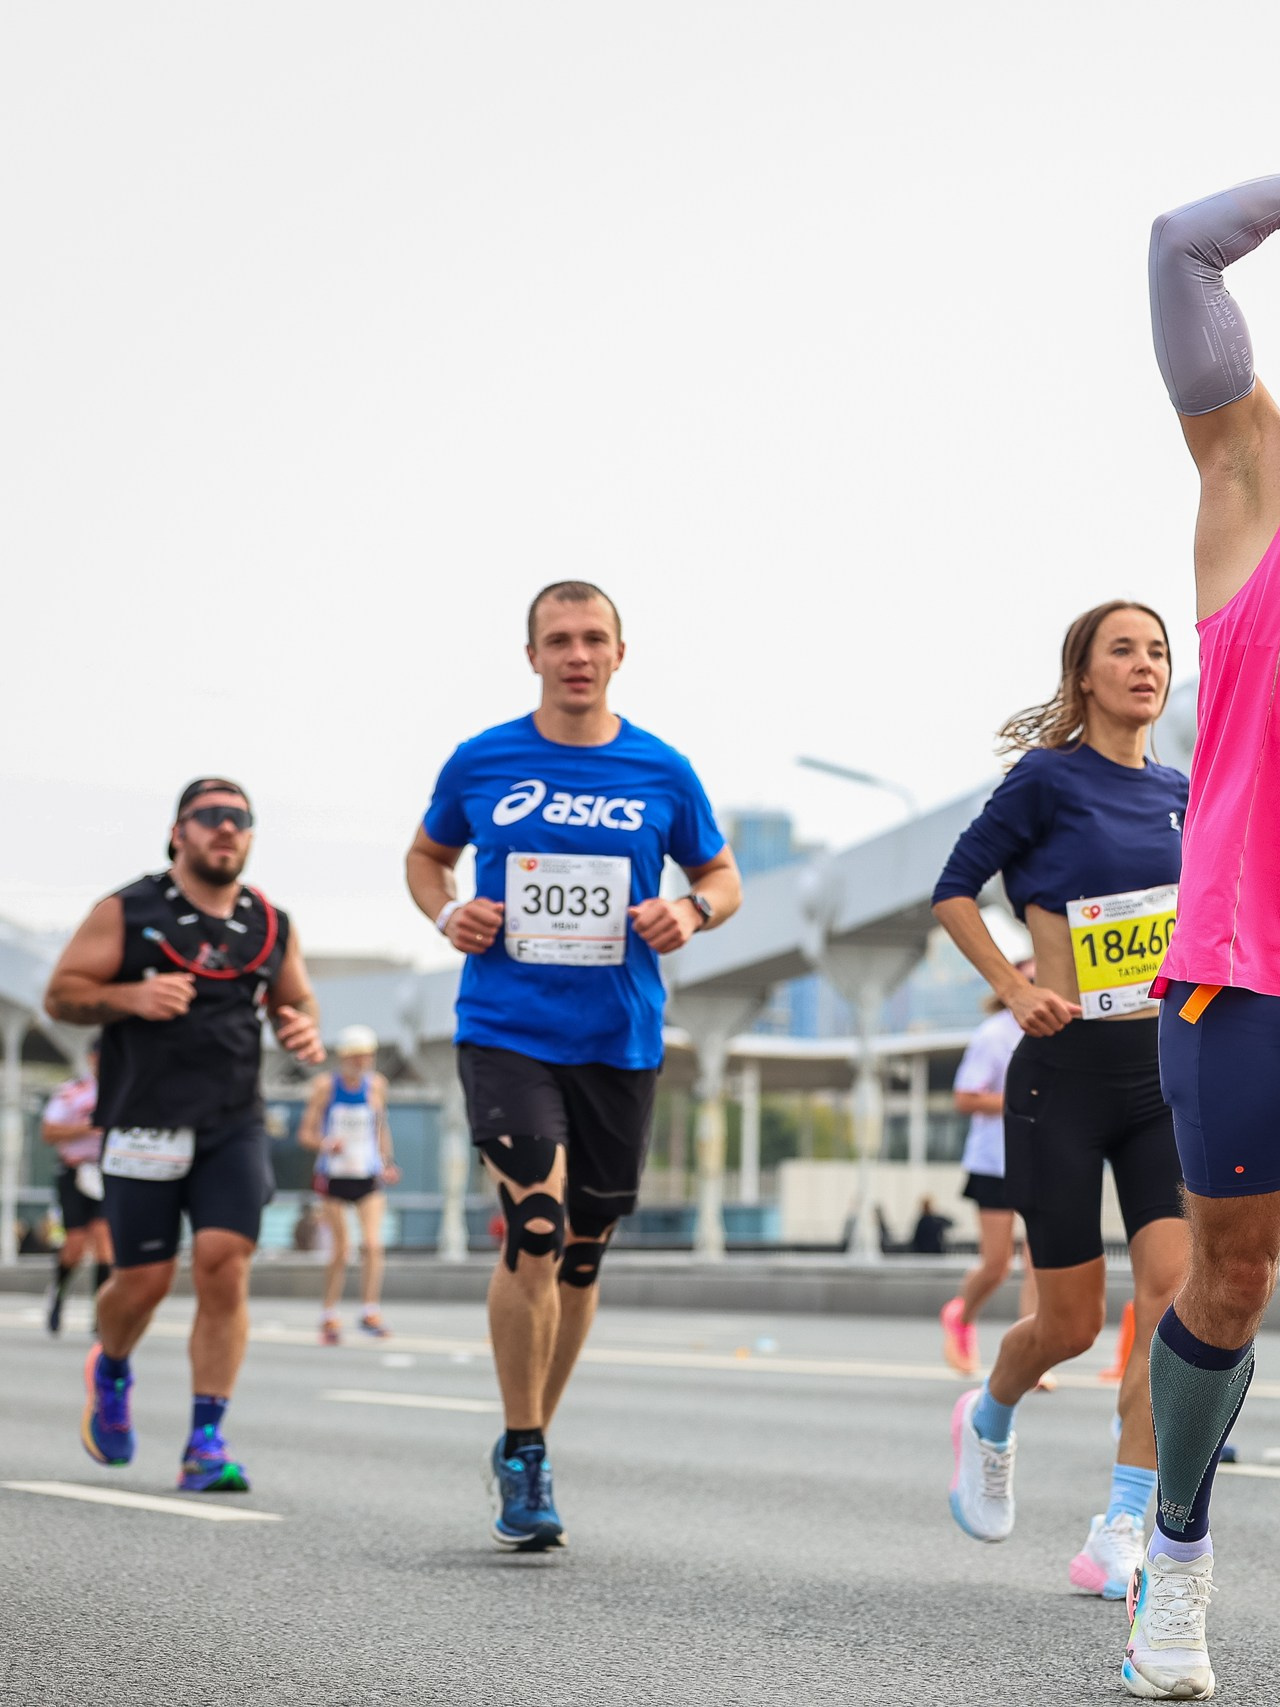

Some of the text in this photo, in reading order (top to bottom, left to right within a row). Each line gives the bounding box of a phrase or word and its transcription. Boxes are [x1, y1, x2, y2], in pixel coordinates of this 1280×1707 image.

[1216, 294, 1237, 327] DEMIX
[1240, 347, 1252, 372] RUN
[522, 884, 610, 917] 3033
[1099, 993, 1113, 1011] G
